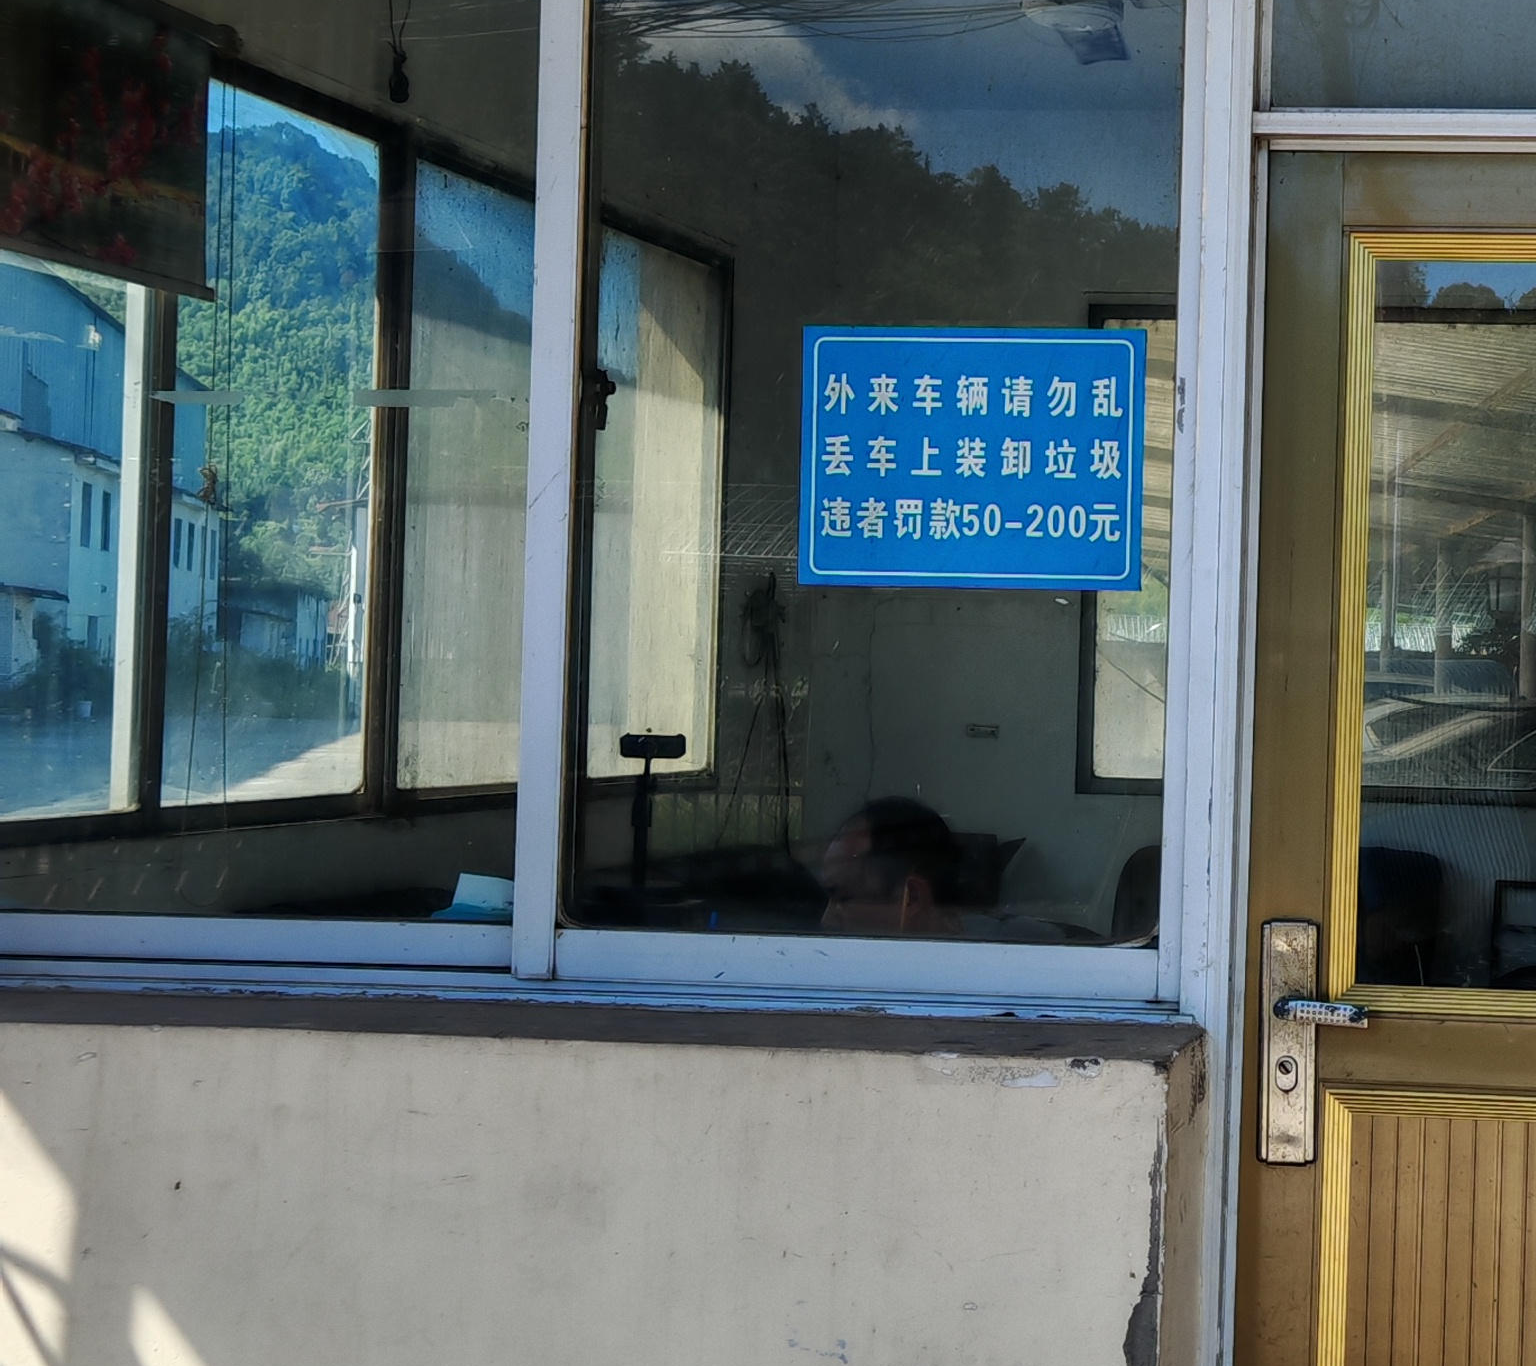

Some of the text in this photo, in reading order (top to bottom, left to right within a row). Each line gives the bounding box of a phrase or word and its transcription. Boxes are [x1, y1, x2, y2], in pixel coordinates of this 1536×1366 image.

[823, 373, 1124, 418] 外来车辆请勿乱
[821, 435, 1123, 480] 丢车上装卸垃圾
[820, 497, 1122, 543] 违者罚款50-200元
